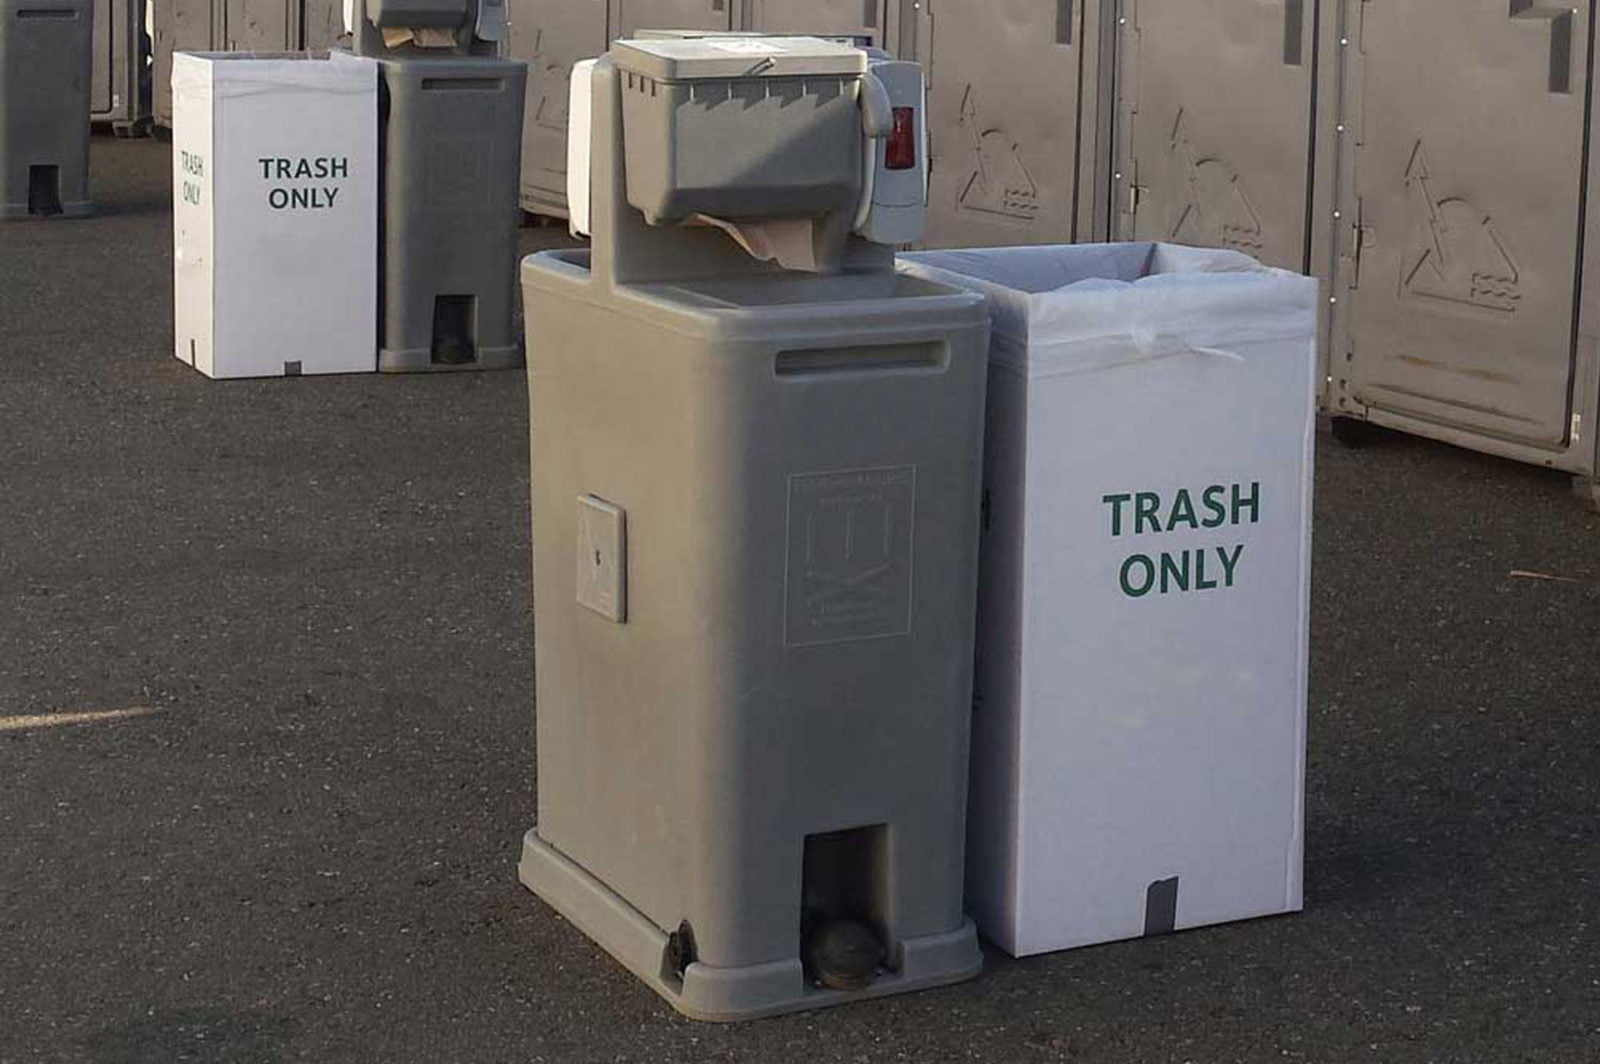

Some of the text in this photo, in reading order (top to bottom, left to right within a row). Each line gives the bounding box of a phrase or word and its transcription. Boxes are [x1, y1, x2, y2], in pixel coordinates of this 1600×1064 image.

[181, 151, 203, 177] TRASH
[258, 157, 348, 180] TRASH
[183, 181, 201, 205] ONLY
[269, 188, 339, 209] ONLY
[1103, 482, 1260, 536] TRASH
[1119, 544, 1244, 598] ONLY
